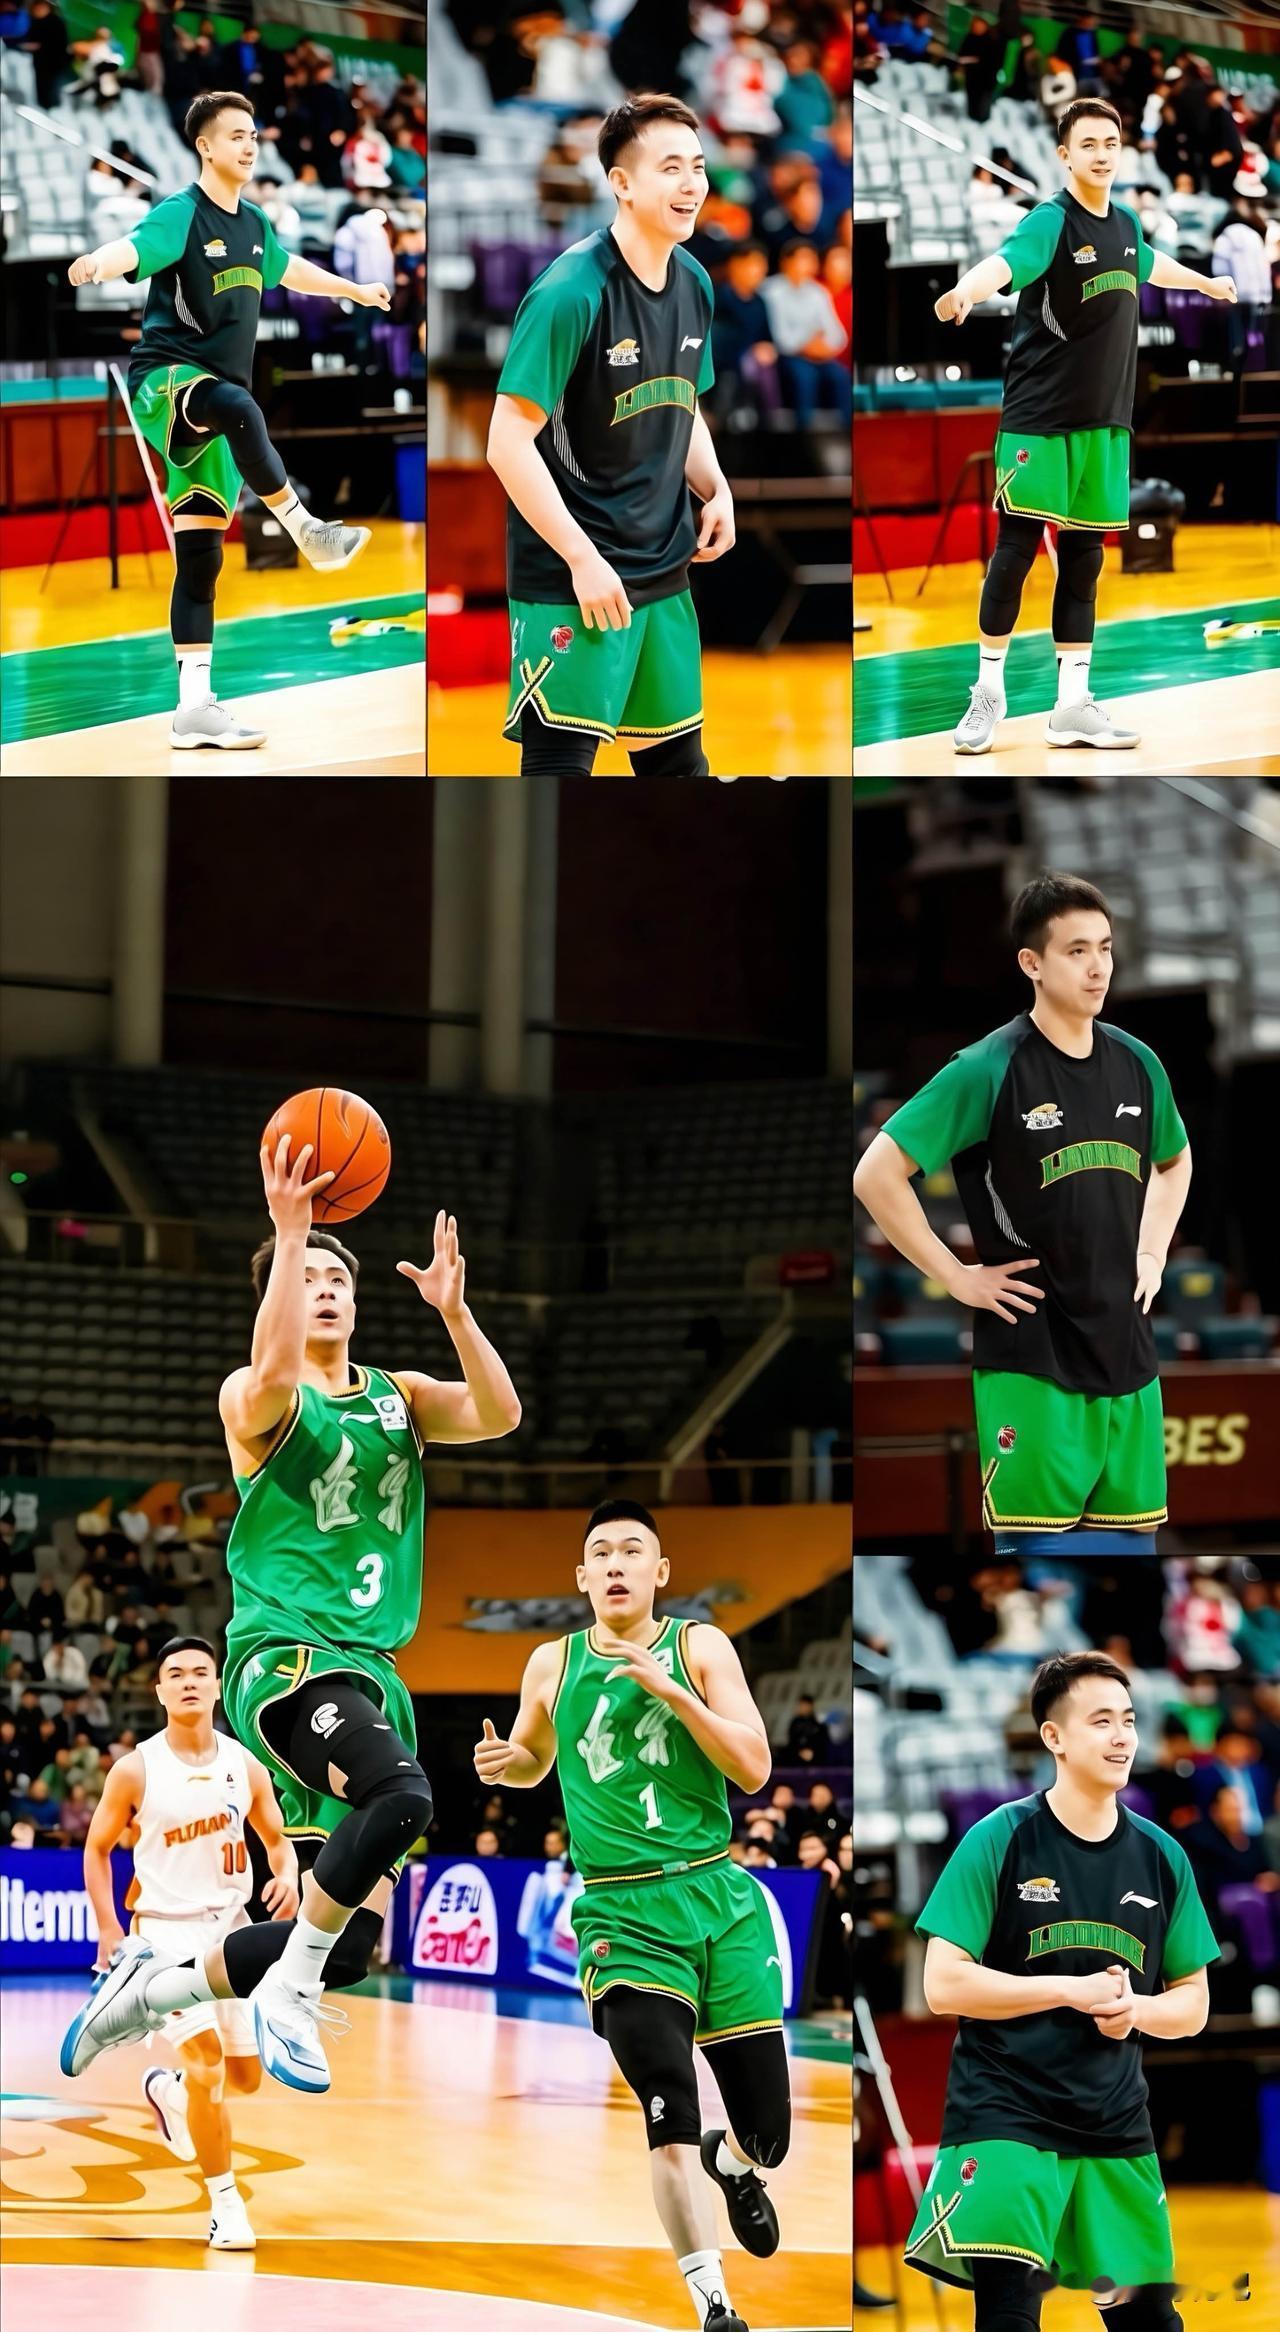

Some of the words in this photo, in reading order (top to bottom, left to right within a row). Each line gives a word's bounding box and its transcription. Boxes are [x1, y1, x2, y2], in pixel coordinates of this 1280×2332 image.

[350, 1553, 384, 1607] 3
[639, 1782, 665, 1829] 1
[221, 1840, 247, 1875] 10
